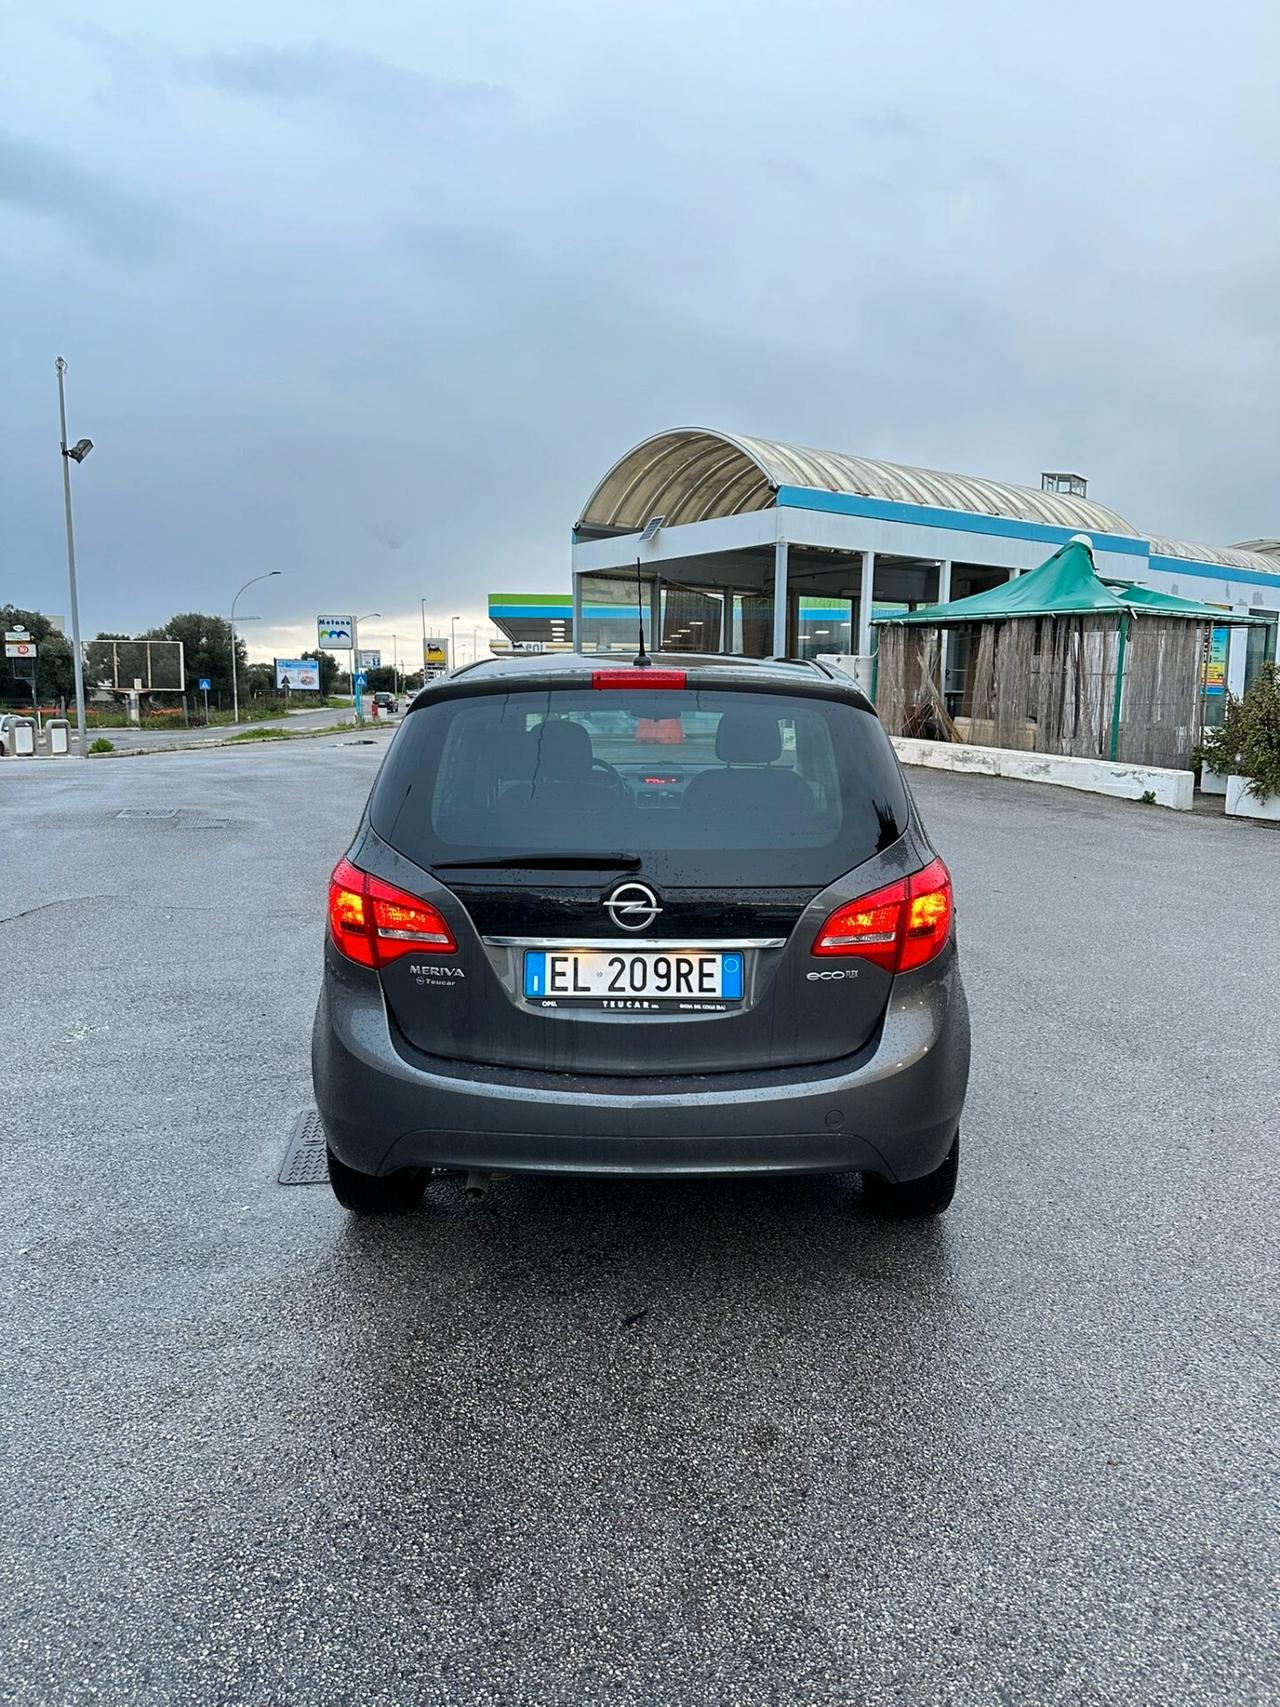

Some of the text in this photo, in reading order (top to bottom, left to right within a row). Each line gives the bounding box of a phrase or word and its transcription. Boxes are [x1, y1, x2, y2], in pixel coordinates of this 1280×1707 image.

[525, 641, 544, 653] eni
[409, 965, 465, 978] MERIVA
[550, 956, 717, 993] EL 209RE
[425, 978, 456, 986] Teucar
[602, 1001, 650, 1009] TEUCAR
